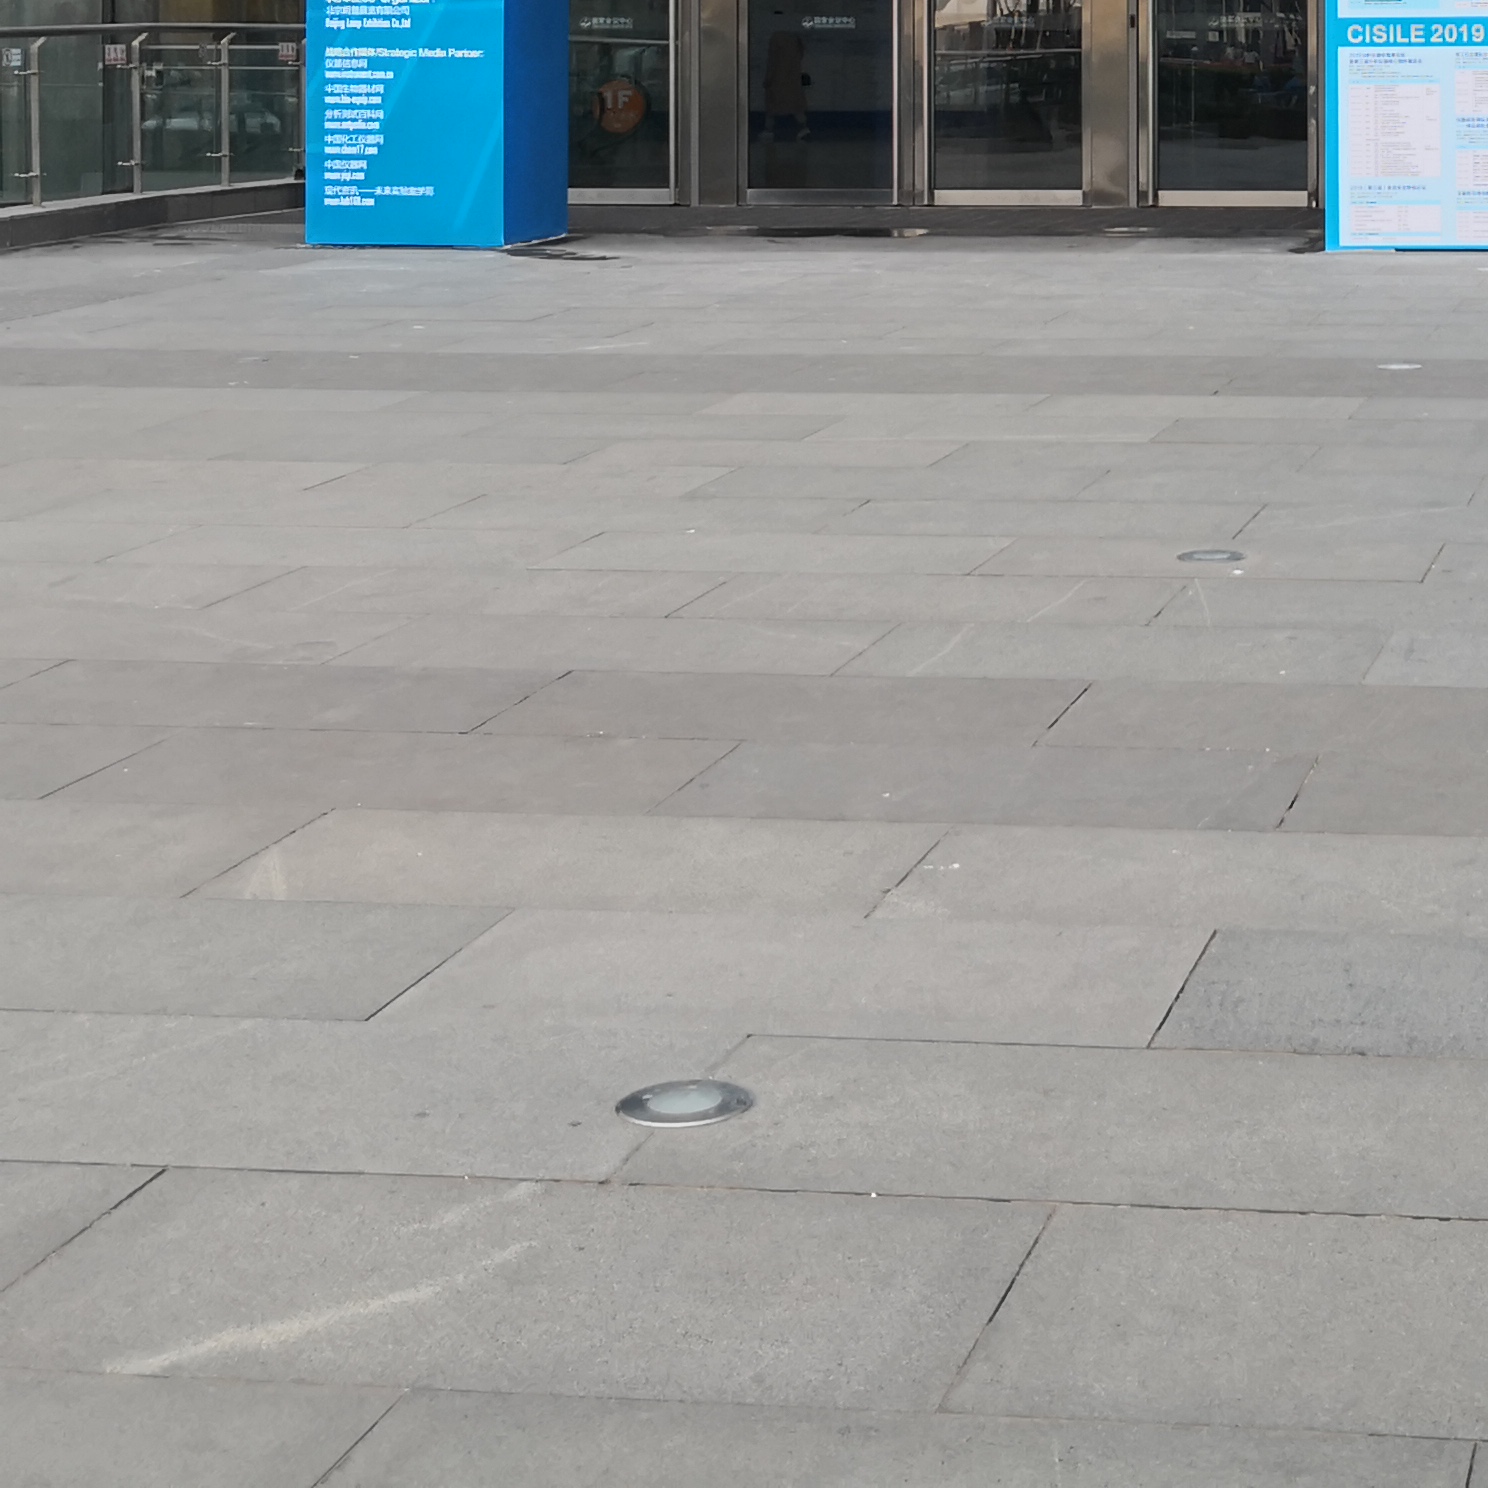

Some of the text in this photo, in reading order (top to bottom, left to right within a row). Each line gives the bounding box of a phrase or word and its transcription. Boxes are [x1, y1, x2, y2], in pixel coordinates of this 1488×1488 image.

[1347, 24, 1426, 43] CISILE
[1430, 23, 1485, 42] 2019
[603, 90, 632, 109] 1F
